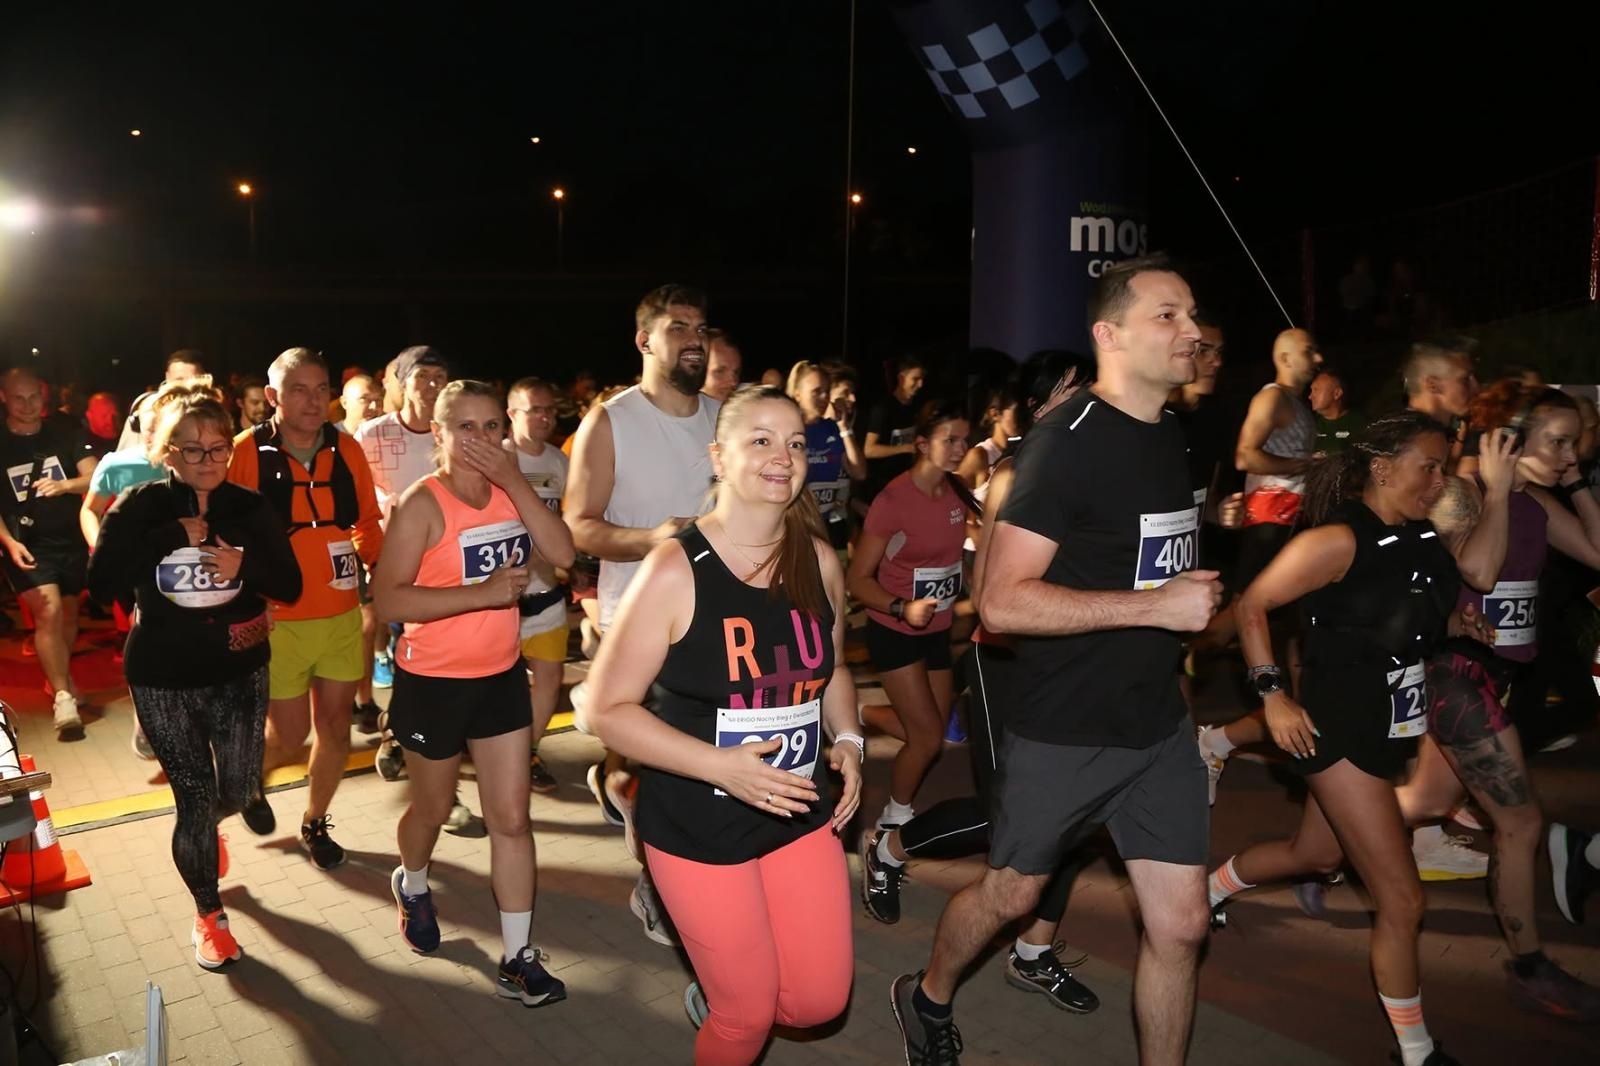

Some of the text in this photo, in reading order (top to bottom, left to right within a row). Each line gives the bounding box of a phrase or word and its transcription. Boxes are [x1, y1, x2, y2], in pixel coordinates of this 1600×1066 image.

[478, 537, 524, 573] 316
[1154, 534, 1193, 574] 400
[173, 565, 230, 590] 28
[924, 577, 955, 600] 263
[1498, 598, 1536, 627] 256
[1405, 683, 1427, 718] 2
[740, 729, 807, 769] 99
